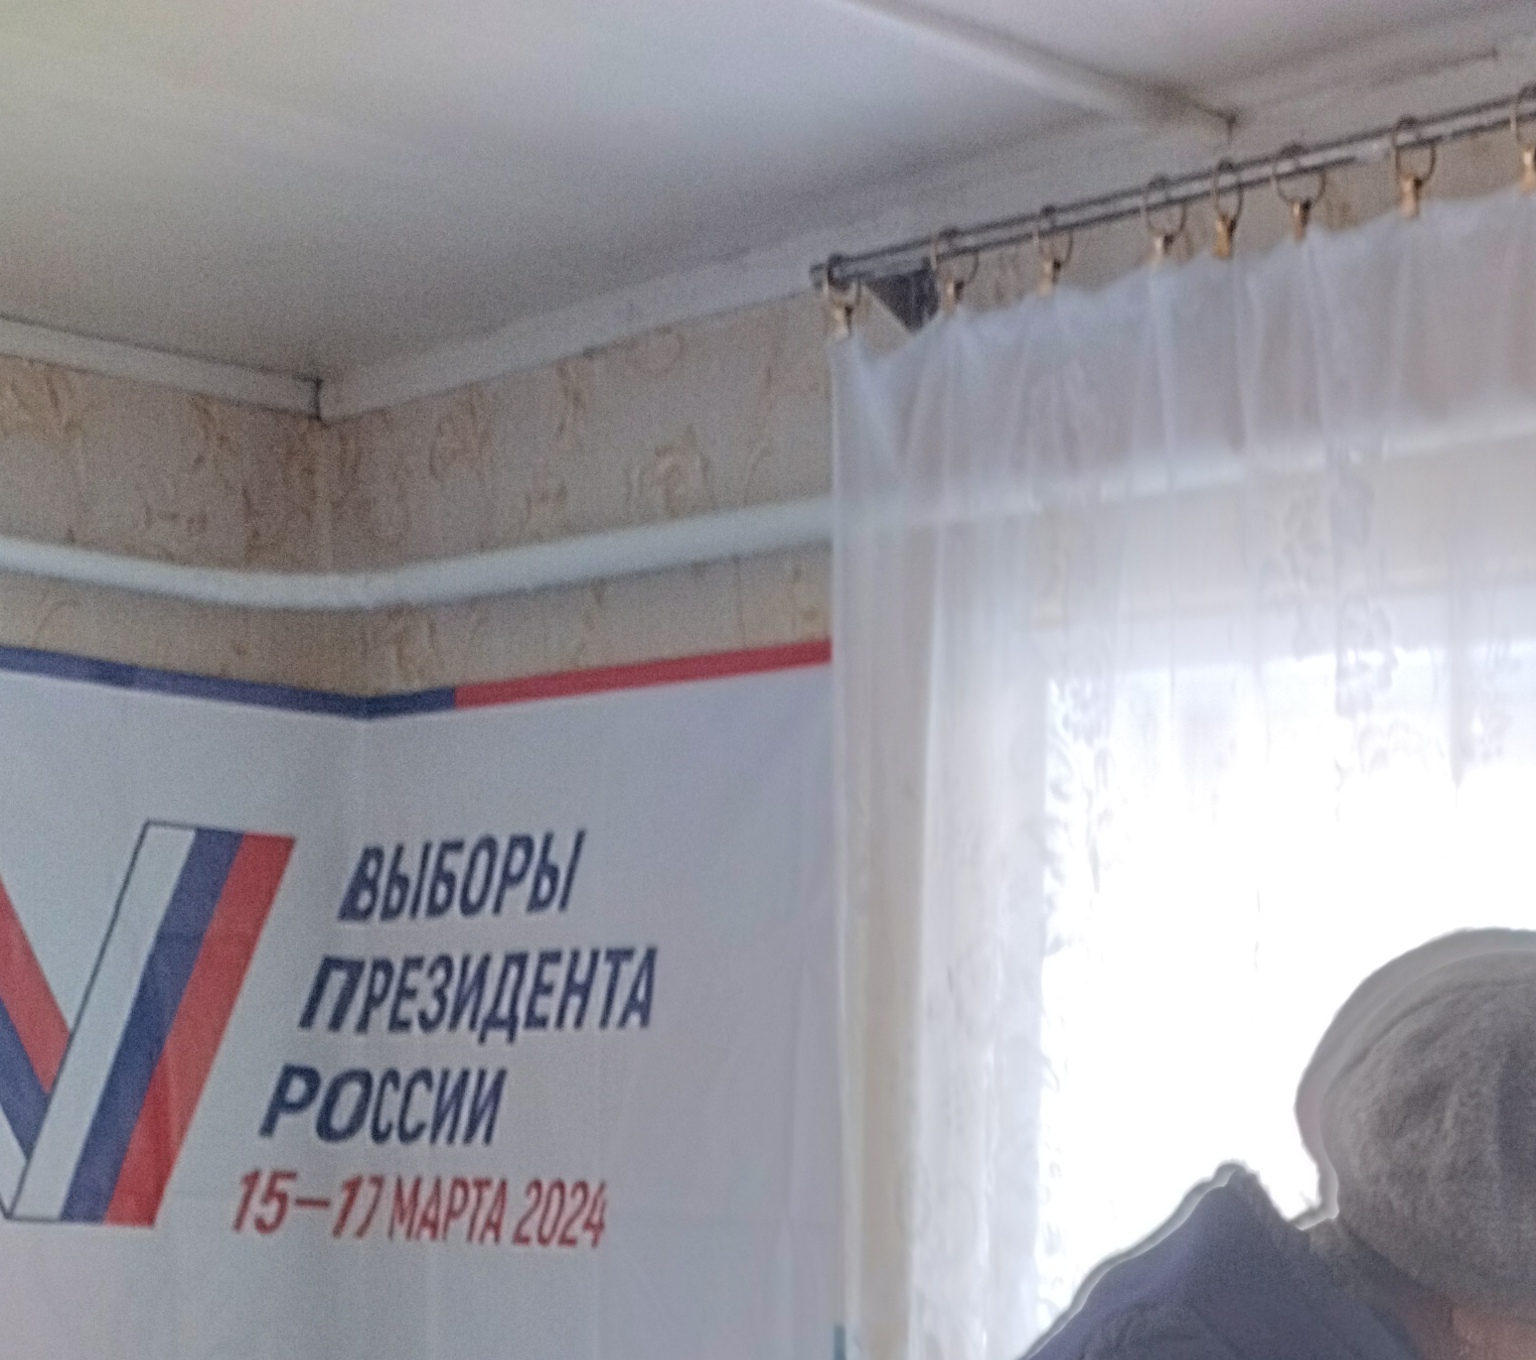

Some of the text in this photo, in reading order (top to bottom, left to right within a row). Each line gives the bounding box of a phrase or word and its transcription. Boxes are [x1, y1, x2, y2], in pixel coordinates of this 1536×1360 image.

[337, 828, 586, 922] ВЫБОРЫ
[299, 946, 659, 1044] ПРЕЗИДЕНТА
[258, 1064, 507, 1146] РОССИИ
[391, 1175, 508, 1244] МАРТА
[512, 1179, 607, 1249] 2024
